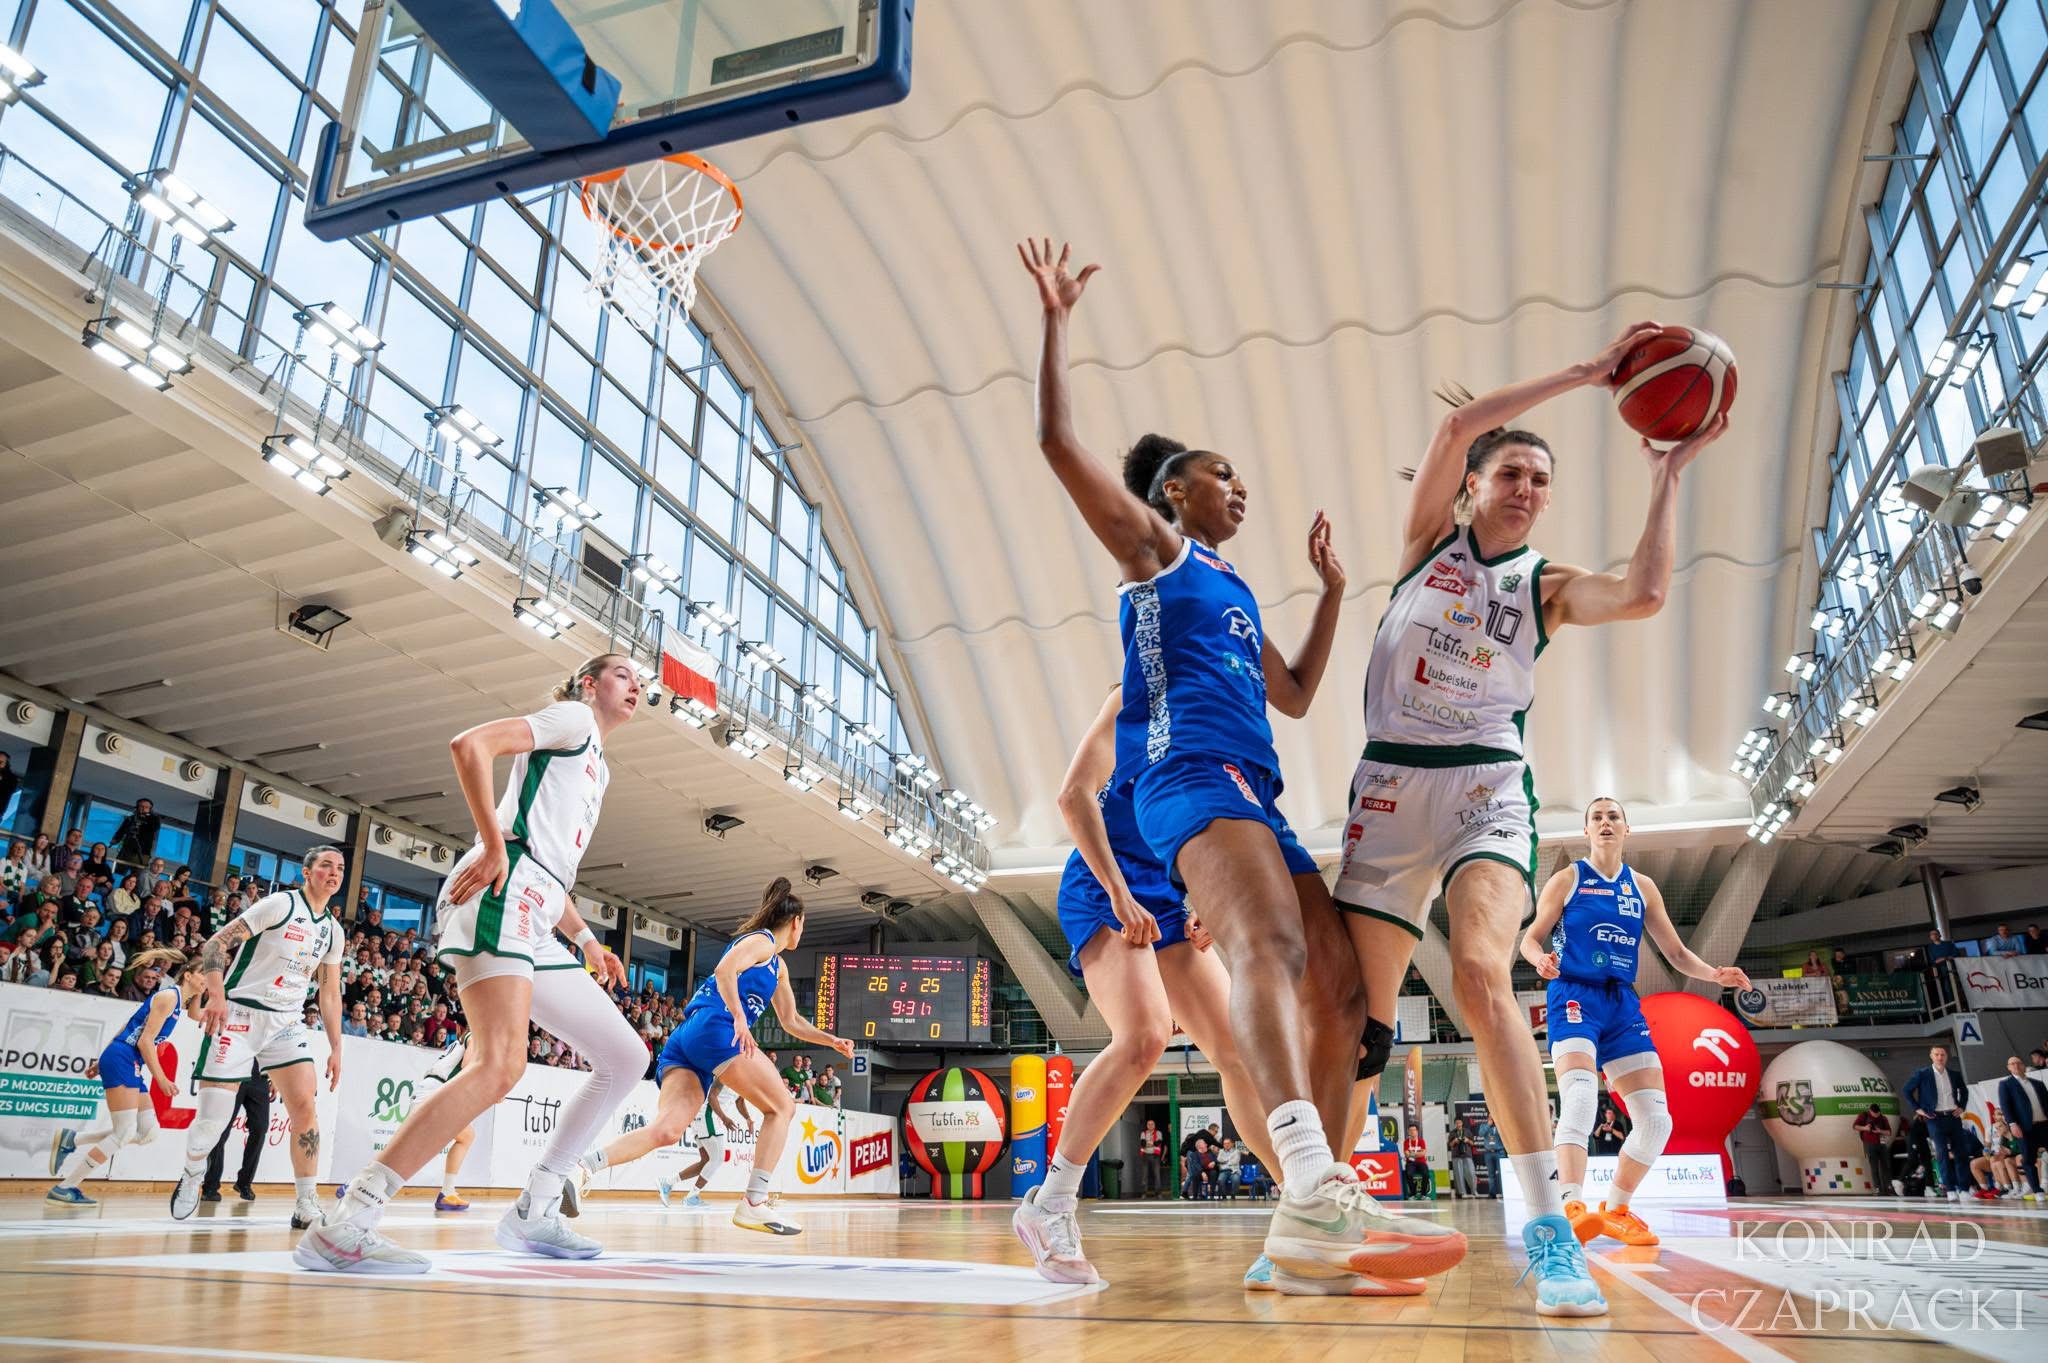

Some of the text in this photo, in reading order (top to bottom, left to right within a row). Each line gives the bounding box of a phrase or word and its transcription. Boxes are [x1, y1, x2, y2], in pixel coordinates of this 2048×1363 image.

[1430, 580, 1464, 596] PERŁA
[1485, 600, 1523, 645] 10
[1402, 694, 1479, 726] LUXIONA
[1617, 895, 1642, 920] 20
[1597, 929, 1636, 948] Enea
[868, 976, 941, 993] 26 2 25
[865, 1021, 941, 1038] 0 0
[1961, 1022, 1981, 1041] A
[0, 1049, 98, 1074] PONSO
[854, 1056, 867, 1073] B
[12, 1080, 104, 1097] MŁODZIEŻOWYC
[1688, 1071, 1747, 1089] ORLEN
[1407, 1069, 1416, 1117] UMCS
[16, 1101, 50, 1113] UMCS
[52, 1104, 92, 1116] LUBLIN
[523, 1138, 547, 1147] MIAST
[806, 1141, 834, 1173] LOTTO
[855, 1138, 889, 1168] PERŁA
